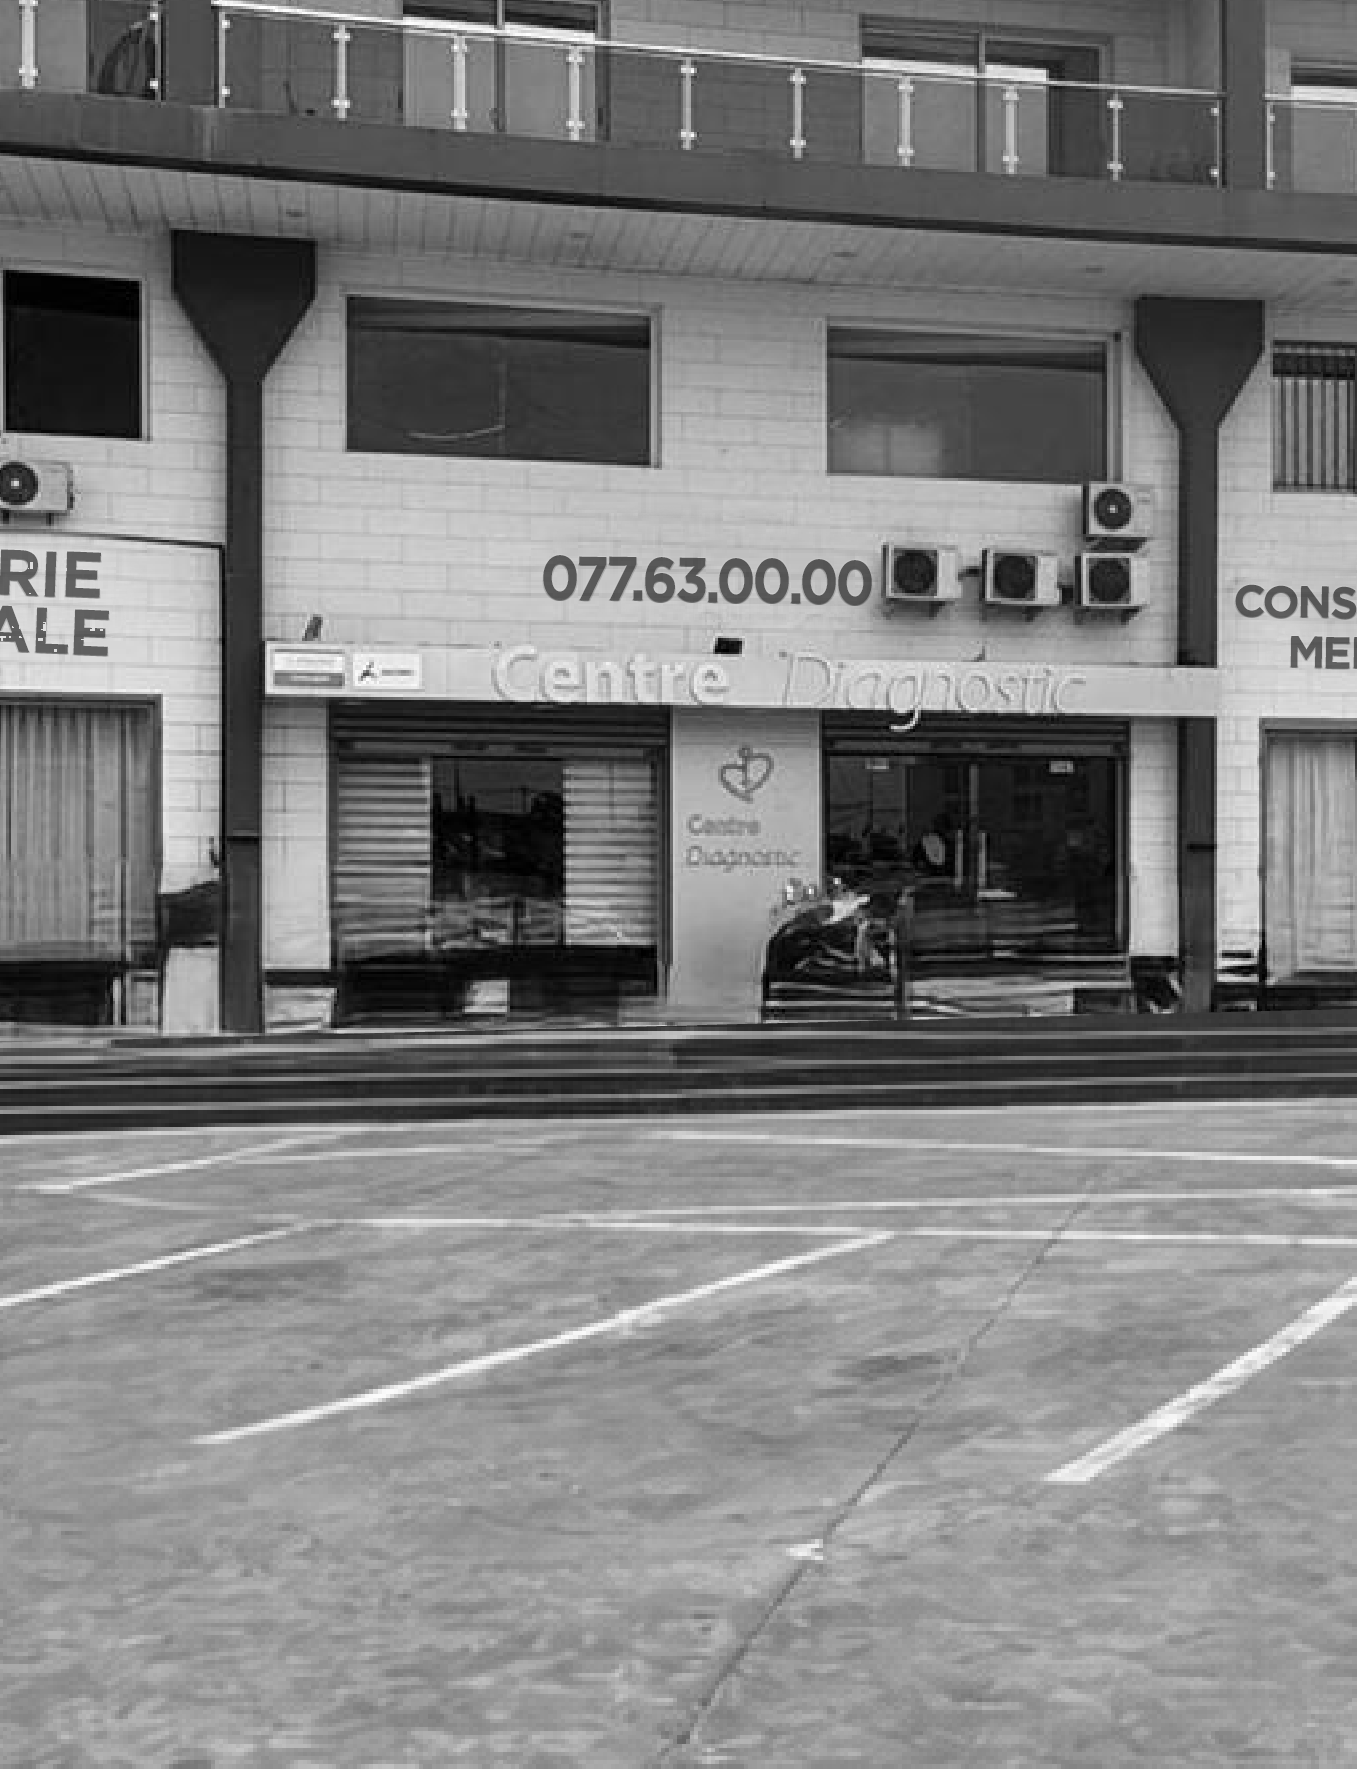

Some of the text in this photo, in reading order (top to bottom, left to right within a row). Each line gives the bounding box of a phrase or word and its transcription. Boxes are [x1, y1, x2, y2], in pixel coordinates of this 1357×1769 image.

[542, 554, 873, 607] 077.63.00.00
[494, 644, 1087, 731] Centre Diagnostic
[686, 813, 761, 836] Centre
